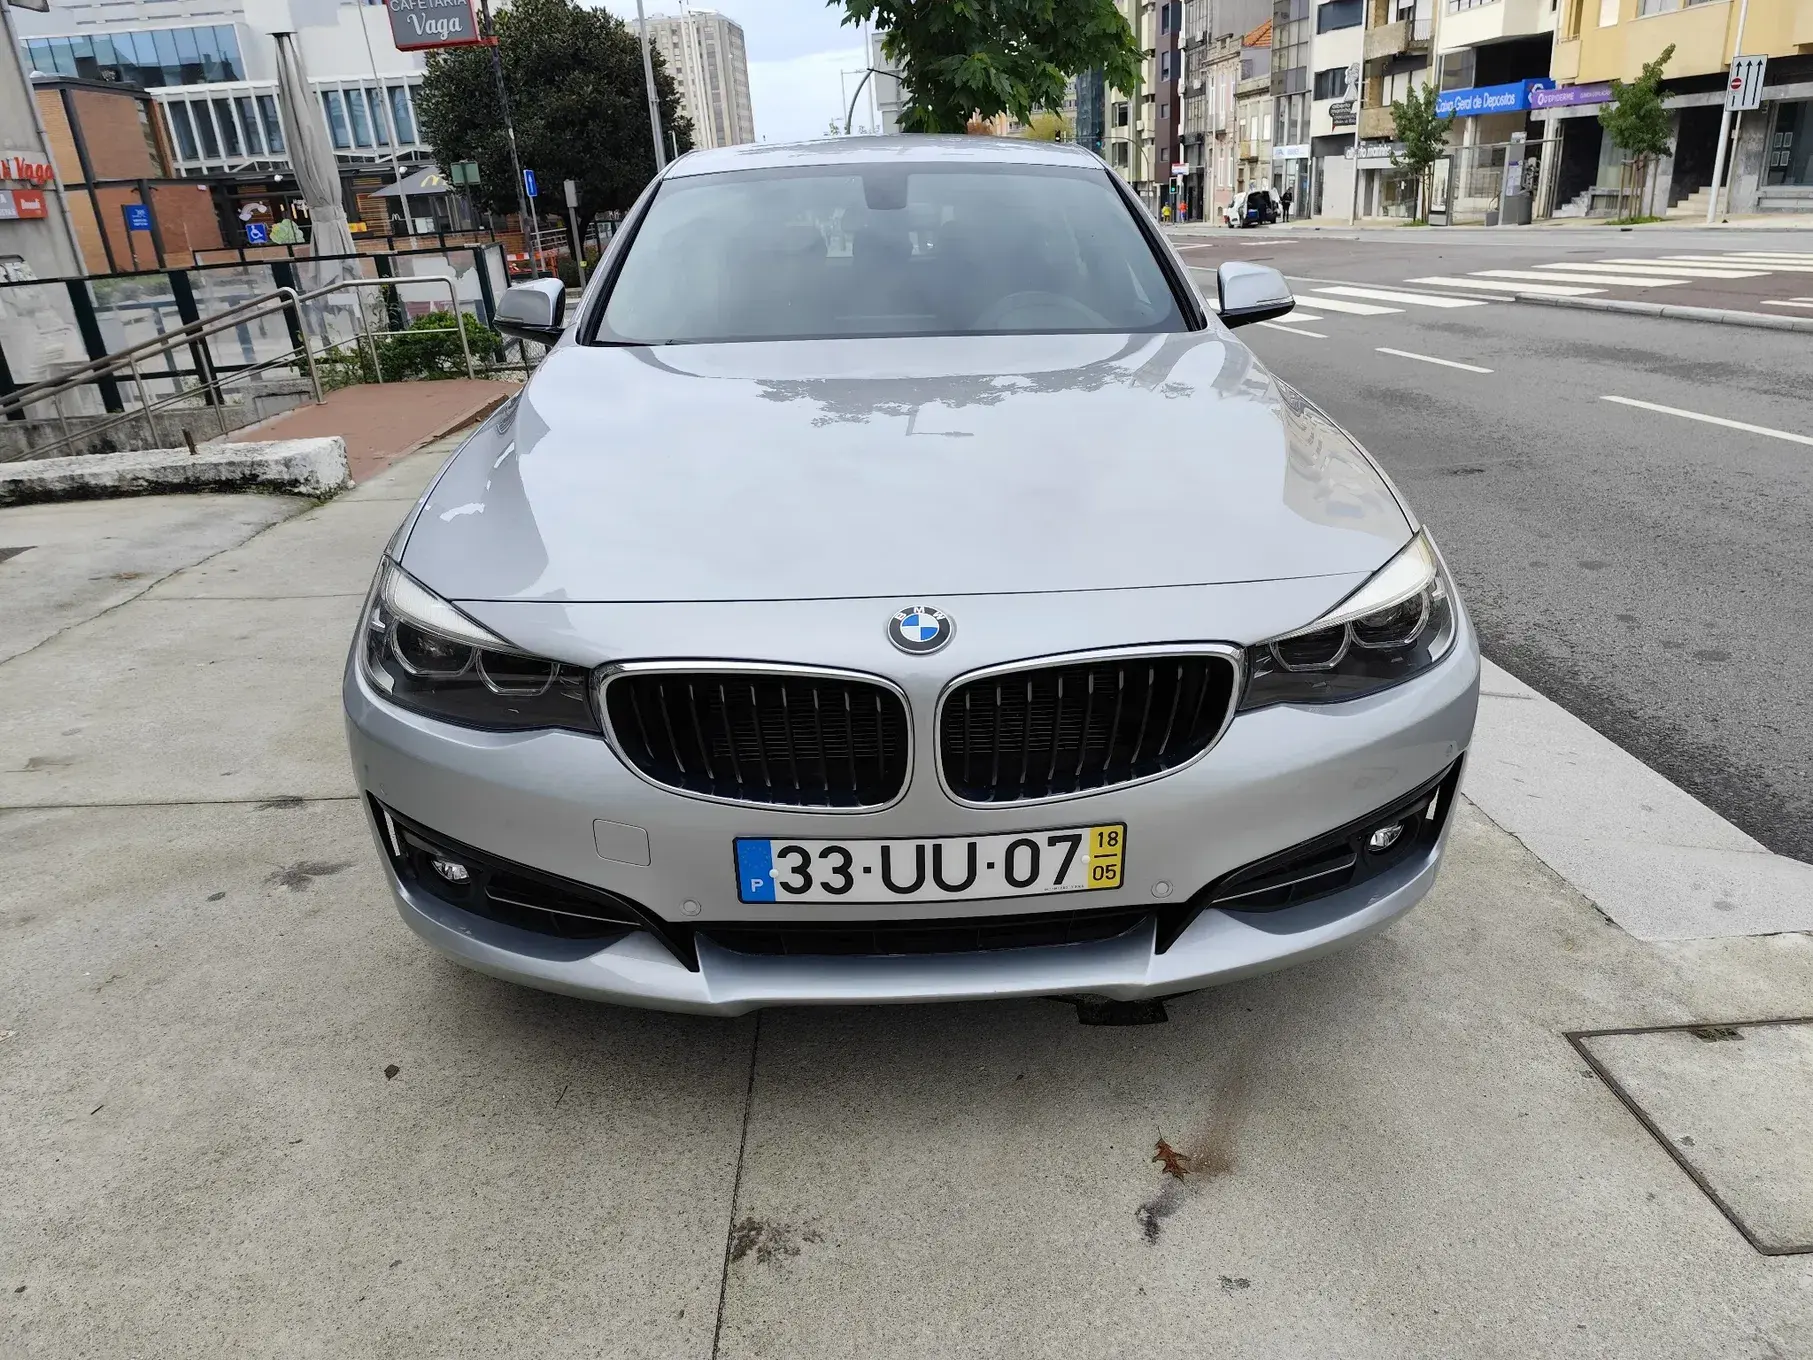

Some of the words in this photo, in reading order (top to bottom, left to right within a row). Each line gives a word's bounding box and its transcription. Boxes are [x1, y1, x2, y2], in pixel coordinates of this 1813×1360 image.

[407, 13, 463, 40] Vaga
[1436, 98, 1453, 113] Caixa
[1454, 95, 1472, 110] Geral
[1473, 95, 1482, 109] de
[12, 157, 55, 185] Vaga
[895, 606, 946, 621] BMW
[1098, 831, 1119, 848] 18
[1093, 864, 1117, 881] 05
[751, 879, 763, 893] P
